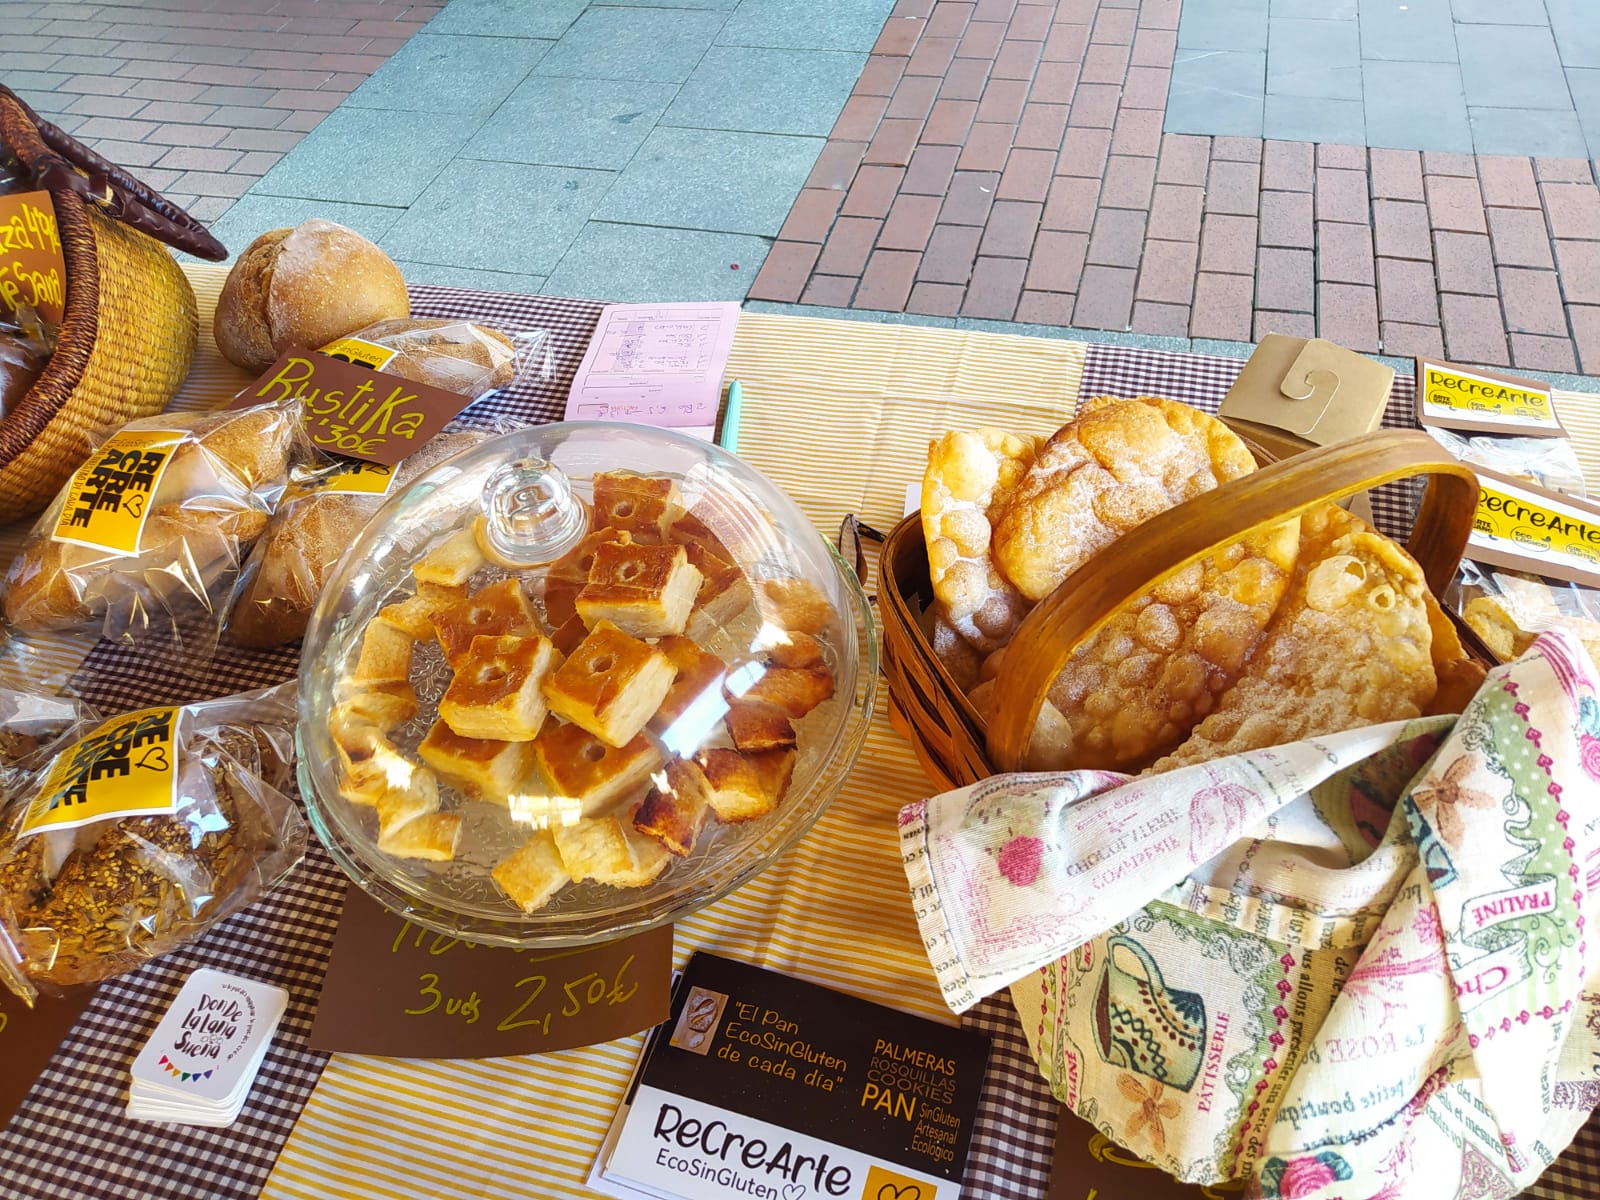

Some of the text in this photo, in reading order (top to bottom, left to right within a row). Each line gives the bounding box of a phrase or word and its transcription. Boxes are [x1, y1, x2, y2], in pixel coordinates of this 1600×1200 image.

[1430, 371, 1544, 407] ReCreArte
[70, 448, 125, 528] ARTE
[96, 450, 143, 513] CRE
[128, 452, 166, 492] RE
[1472, 890, 1551, 927] PRALINÉ
[1295, 972, 1313, 1017] allons
[761, 1009, 799, 1035] Pan
[717, 1043, 741, 1062] de
[748, 1056, 797, 1081] cada
[725, 1021, 847, 1072] EcoSinGluten
[874, 1039, 956, 1076] PALMERAS
[867, 1069, 953, 1105] COOKIES
[870, 1056, 957, 1092] ROSQUILLAS
[861, 1082, 917, 1122] PAN
[919, 1102, 961, 1128] SinGluten
[653, 1103, 852, 1196] ReCreArte
[914, 1119, 958, 1145] Artesanal
[655, 1148, 778, 1200] EcoSinGluten
